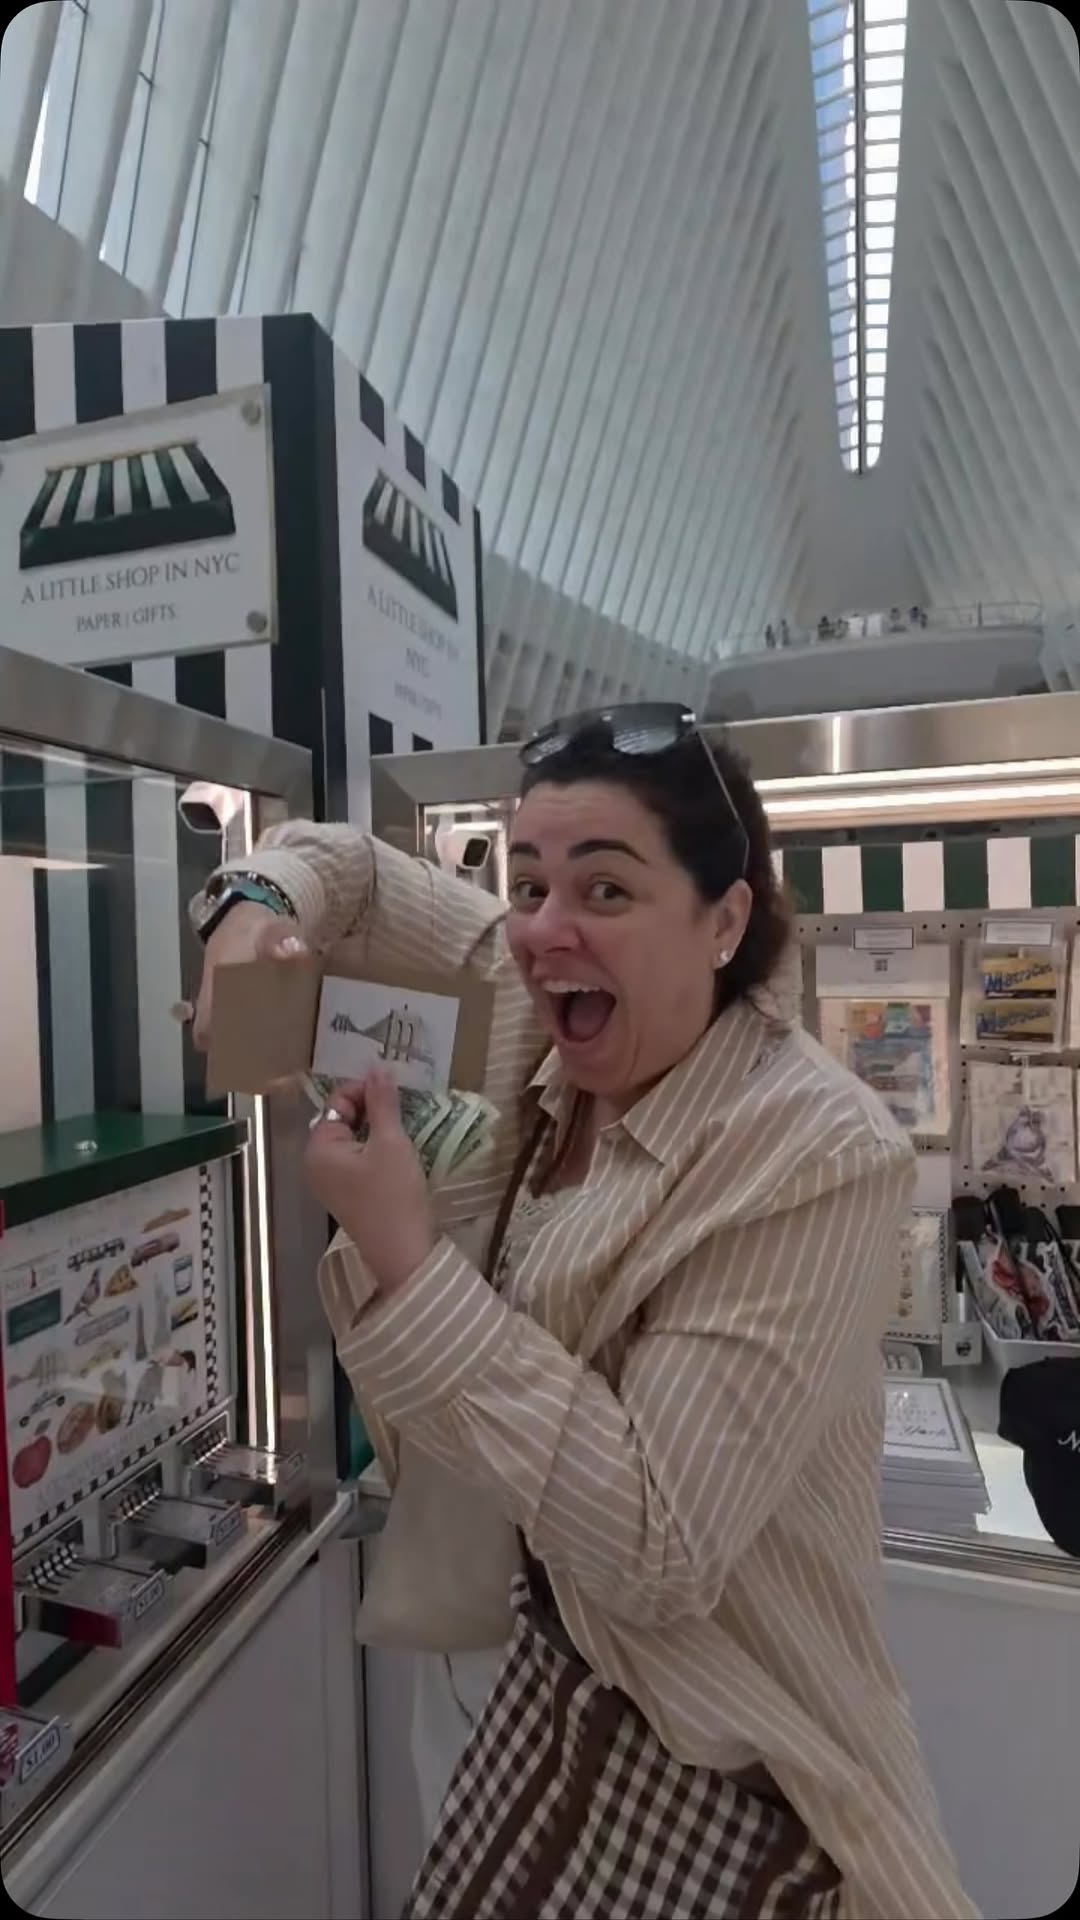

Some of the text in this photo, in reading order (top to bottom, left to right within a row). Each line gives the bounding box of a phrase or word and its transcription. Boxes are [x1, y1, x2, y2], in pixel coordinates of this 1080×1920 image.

[21, 552, 240, 605] A LITTLE SHOP IN NYC
[76, 610, 121, 633] PAPER
[132, 603, 176, 627] GIFTS
[367, 584, 377, 608] A
[378, 588, 417, 635] LITTLE
[26, 1733, 56, 1772] $1.00
